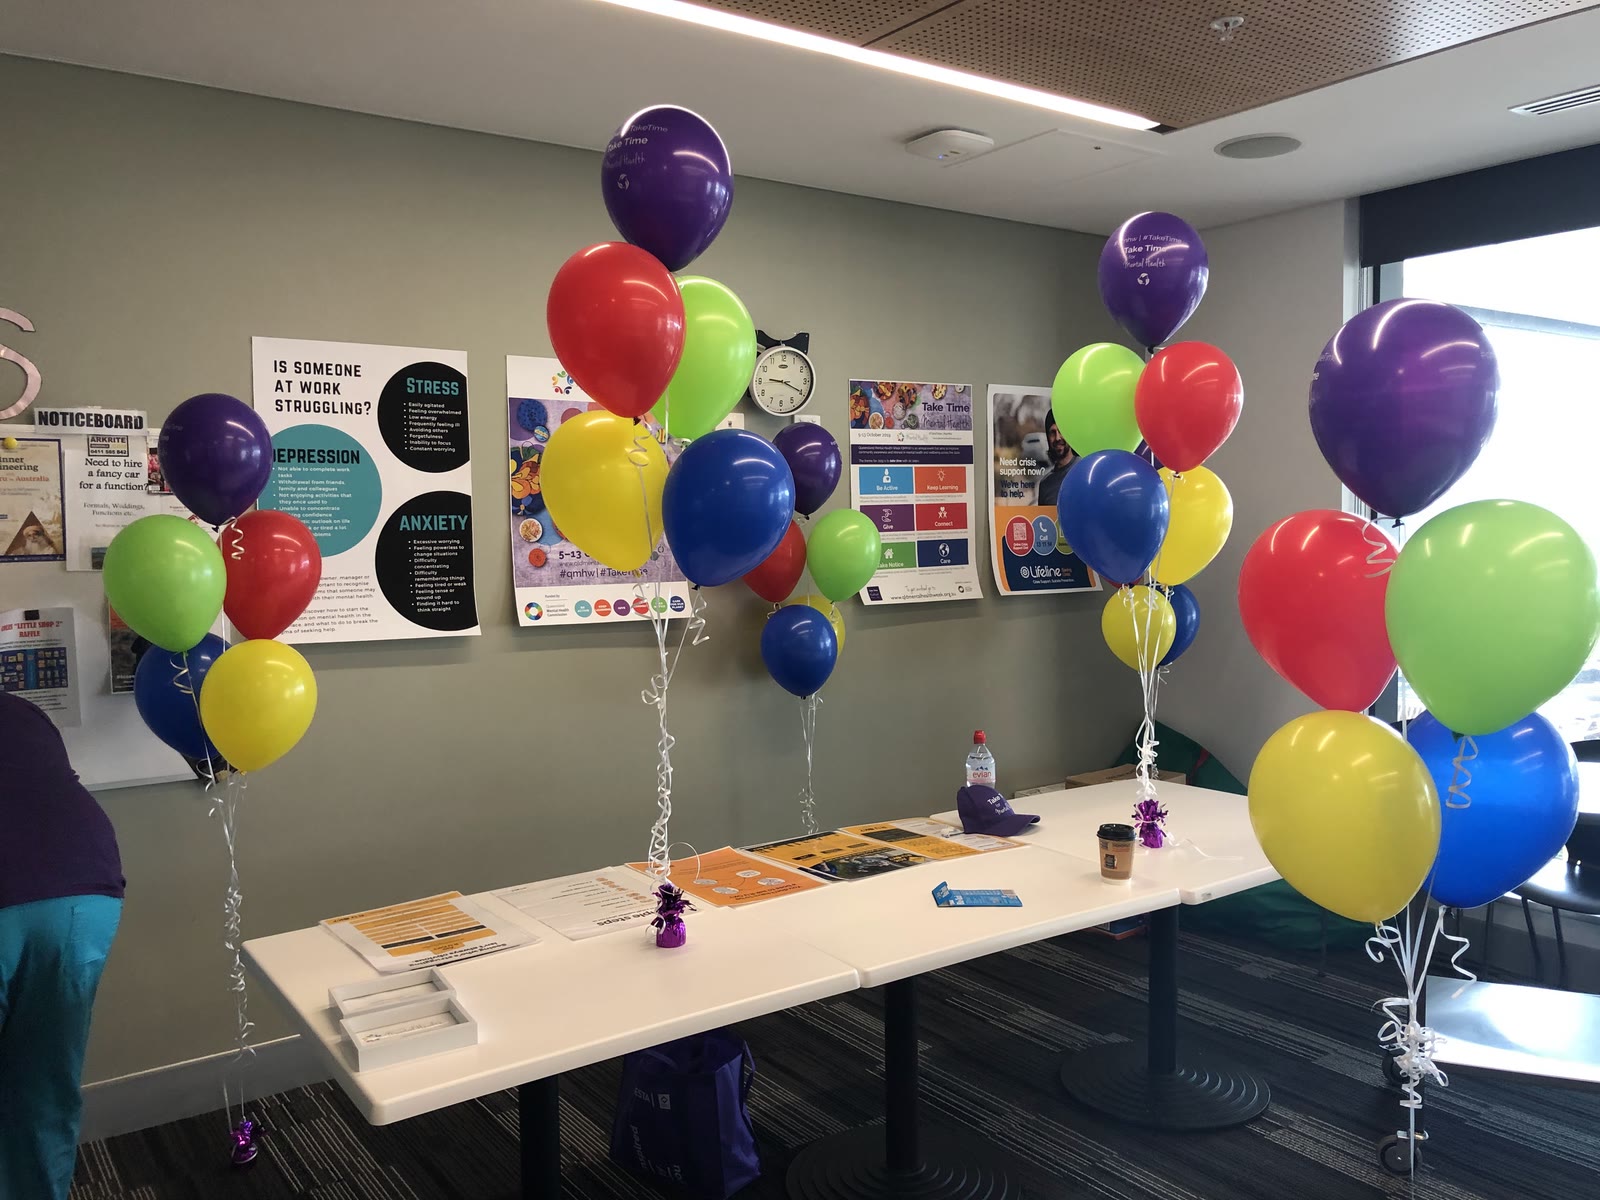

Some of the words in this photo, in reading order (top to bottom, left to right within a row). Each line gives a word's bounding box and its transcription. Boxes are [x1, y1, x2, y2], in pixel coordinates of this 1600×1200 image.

[624, 137, 648, 146] Time
[1124, 246, 1143, 254] Take
[1144, 244, 1167, 252] Time
[1123, 258, 1144, 268] Mental
[1145, 257, 1166, 268] Health
[770, 357, 775, 365] 11
[274, 360, 287, 373] IS
[294, 361, 361, 377] SOMEONE
[762, 365, 768, 373] 10
[800, 365, 804, 373] 2
[274, 380, 293, 393] AT
[300, 381, 341, 395] WORK
[406, 377, 459, 396] STRESS
[275, 399, 372, 416] STRUGGLING?
[921, 402, 944, 411] Take
[946, 402, 970, 413] Time
[38, 411, 144, 430] NOTICEBOARD
[85, 458, 109, 467] Need
[124, 459, 143, 468] hire
[999, 457, 1018, 466] Need
[1019, 457, 1037, 467] crisis
[96, 469, 122, 480] fancy
[999, 467, 1027, 477] support
[1027, 466, 1046, 476] now?
[79, 481, 94, 489] for
[104, 482, 149, 491] function?
[1000, 480, 1019, 489] We're
[1020, 480, 1035, 489] here
[1000, 489, 1008, 498] to
[1009, 489, 1025, 499] help.
[400, 514, 468, 531] ANXIETY
[1029, 565, 1062, 578] Lifeline
[972, 770, 992, 779] evian
[986, 795, 1001, 805] Take
[596, 916, 631, 926] steps
